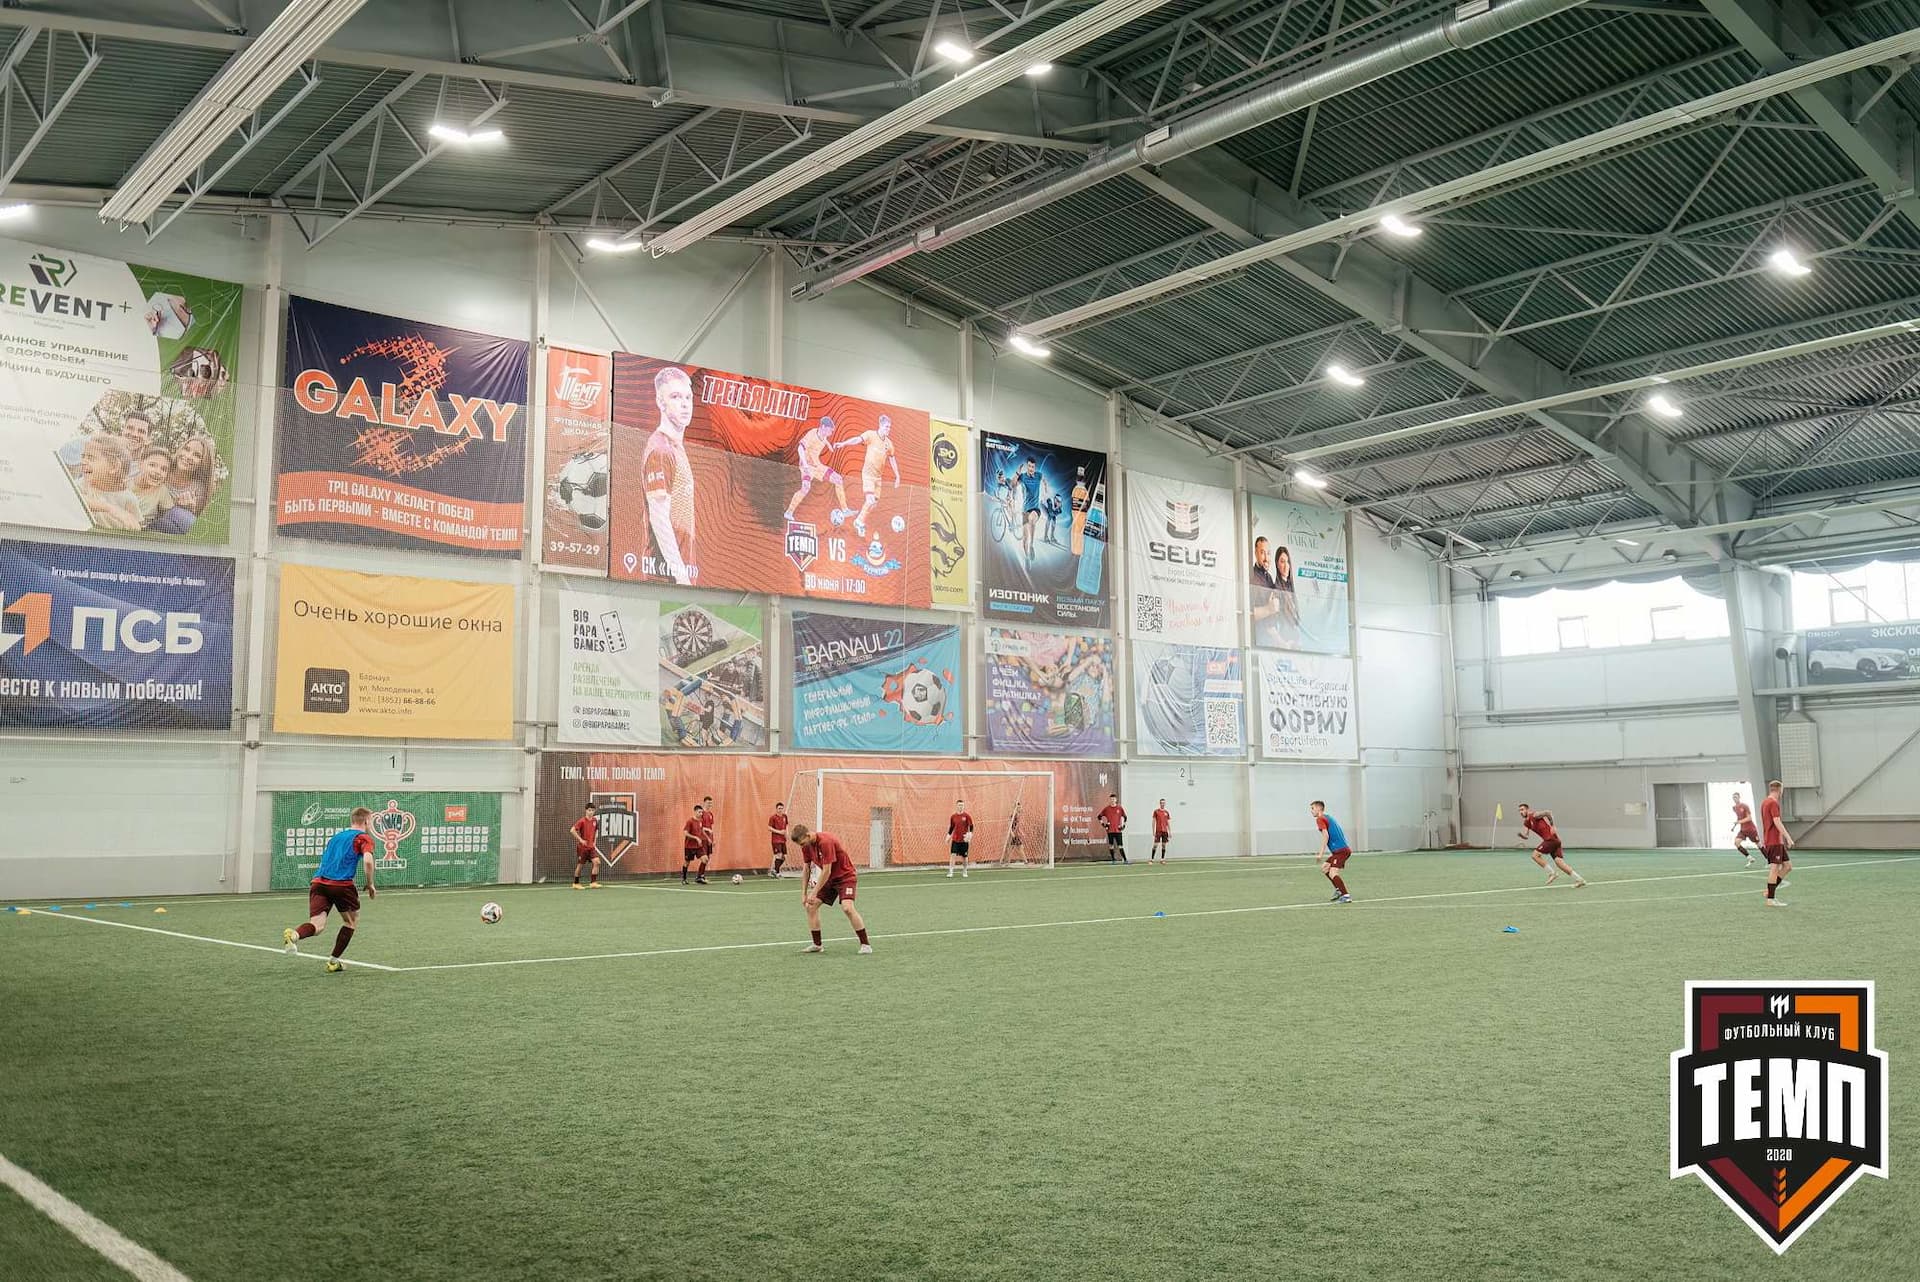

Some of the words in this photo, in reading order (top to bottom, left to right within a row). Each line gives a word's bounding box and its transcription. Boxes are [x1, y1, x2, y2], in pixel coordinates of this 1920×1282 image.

[51, 342, 129, 361] УПРАВЛЕНИЕ
[45, 369, 112, 385] БУДУЩЕГО
[294, 368, 518, 442] GALAXY
[701, 375, 765, 413] ТРЕТЬЯ
[763, 388, 811, 421] ЛИГА
[328, 480, 348, 496] ТРЦ
[351, 484, 392, 502] GALAXY
[394, 490, 437, 512] ЖЕЛАЕТ
[438, 502, 474, 521] ПОБЕД!
[284, 498, 315, 514] БЫТЬ
[318, 498, 372, 517] ПЕРВЫМИ
[382, 508, 422, 528] ВМЕСТЕ
[424, 516, 431, 530] С
[433, 518, 489, 540] КОМАНДОЙ
[550, 541, 601, 556] 39-57-29
[788, 535, 816, 555] ТЕМП
[828, 537, 846, 563] VS
[1149, 541, 1217, 568] SEUS
[641, 556, 657, 575] СК
[846, 578, 866, 594] 17:00
[989, 588, 1050, 605] ИЗОТОНИК
[294, 599, 358, 623] Очень
[364, 608, 453, 630] хорошие
[458, 616, 502, 633] окна
[573, 609, 590, 623] BIG
[71, 606, 204, 654] ПСБ
[573, 624, 598, 639] PAPA
[573, 637, 606, 653] GAMES
[61, 681, 120, 700] новым
[125, 679, 202, 703] победам!
[1269, 707, 1348, 735] ФОРМУ
[389, 755, 396, 769] 1
[560, 766, 585, 781] ТЕМП,
[587, 766, 610, 781] ТЕМП,
[611, 767, 642, 781] ТОЛЬКО
[1180, 767, 1185, 778] 2
